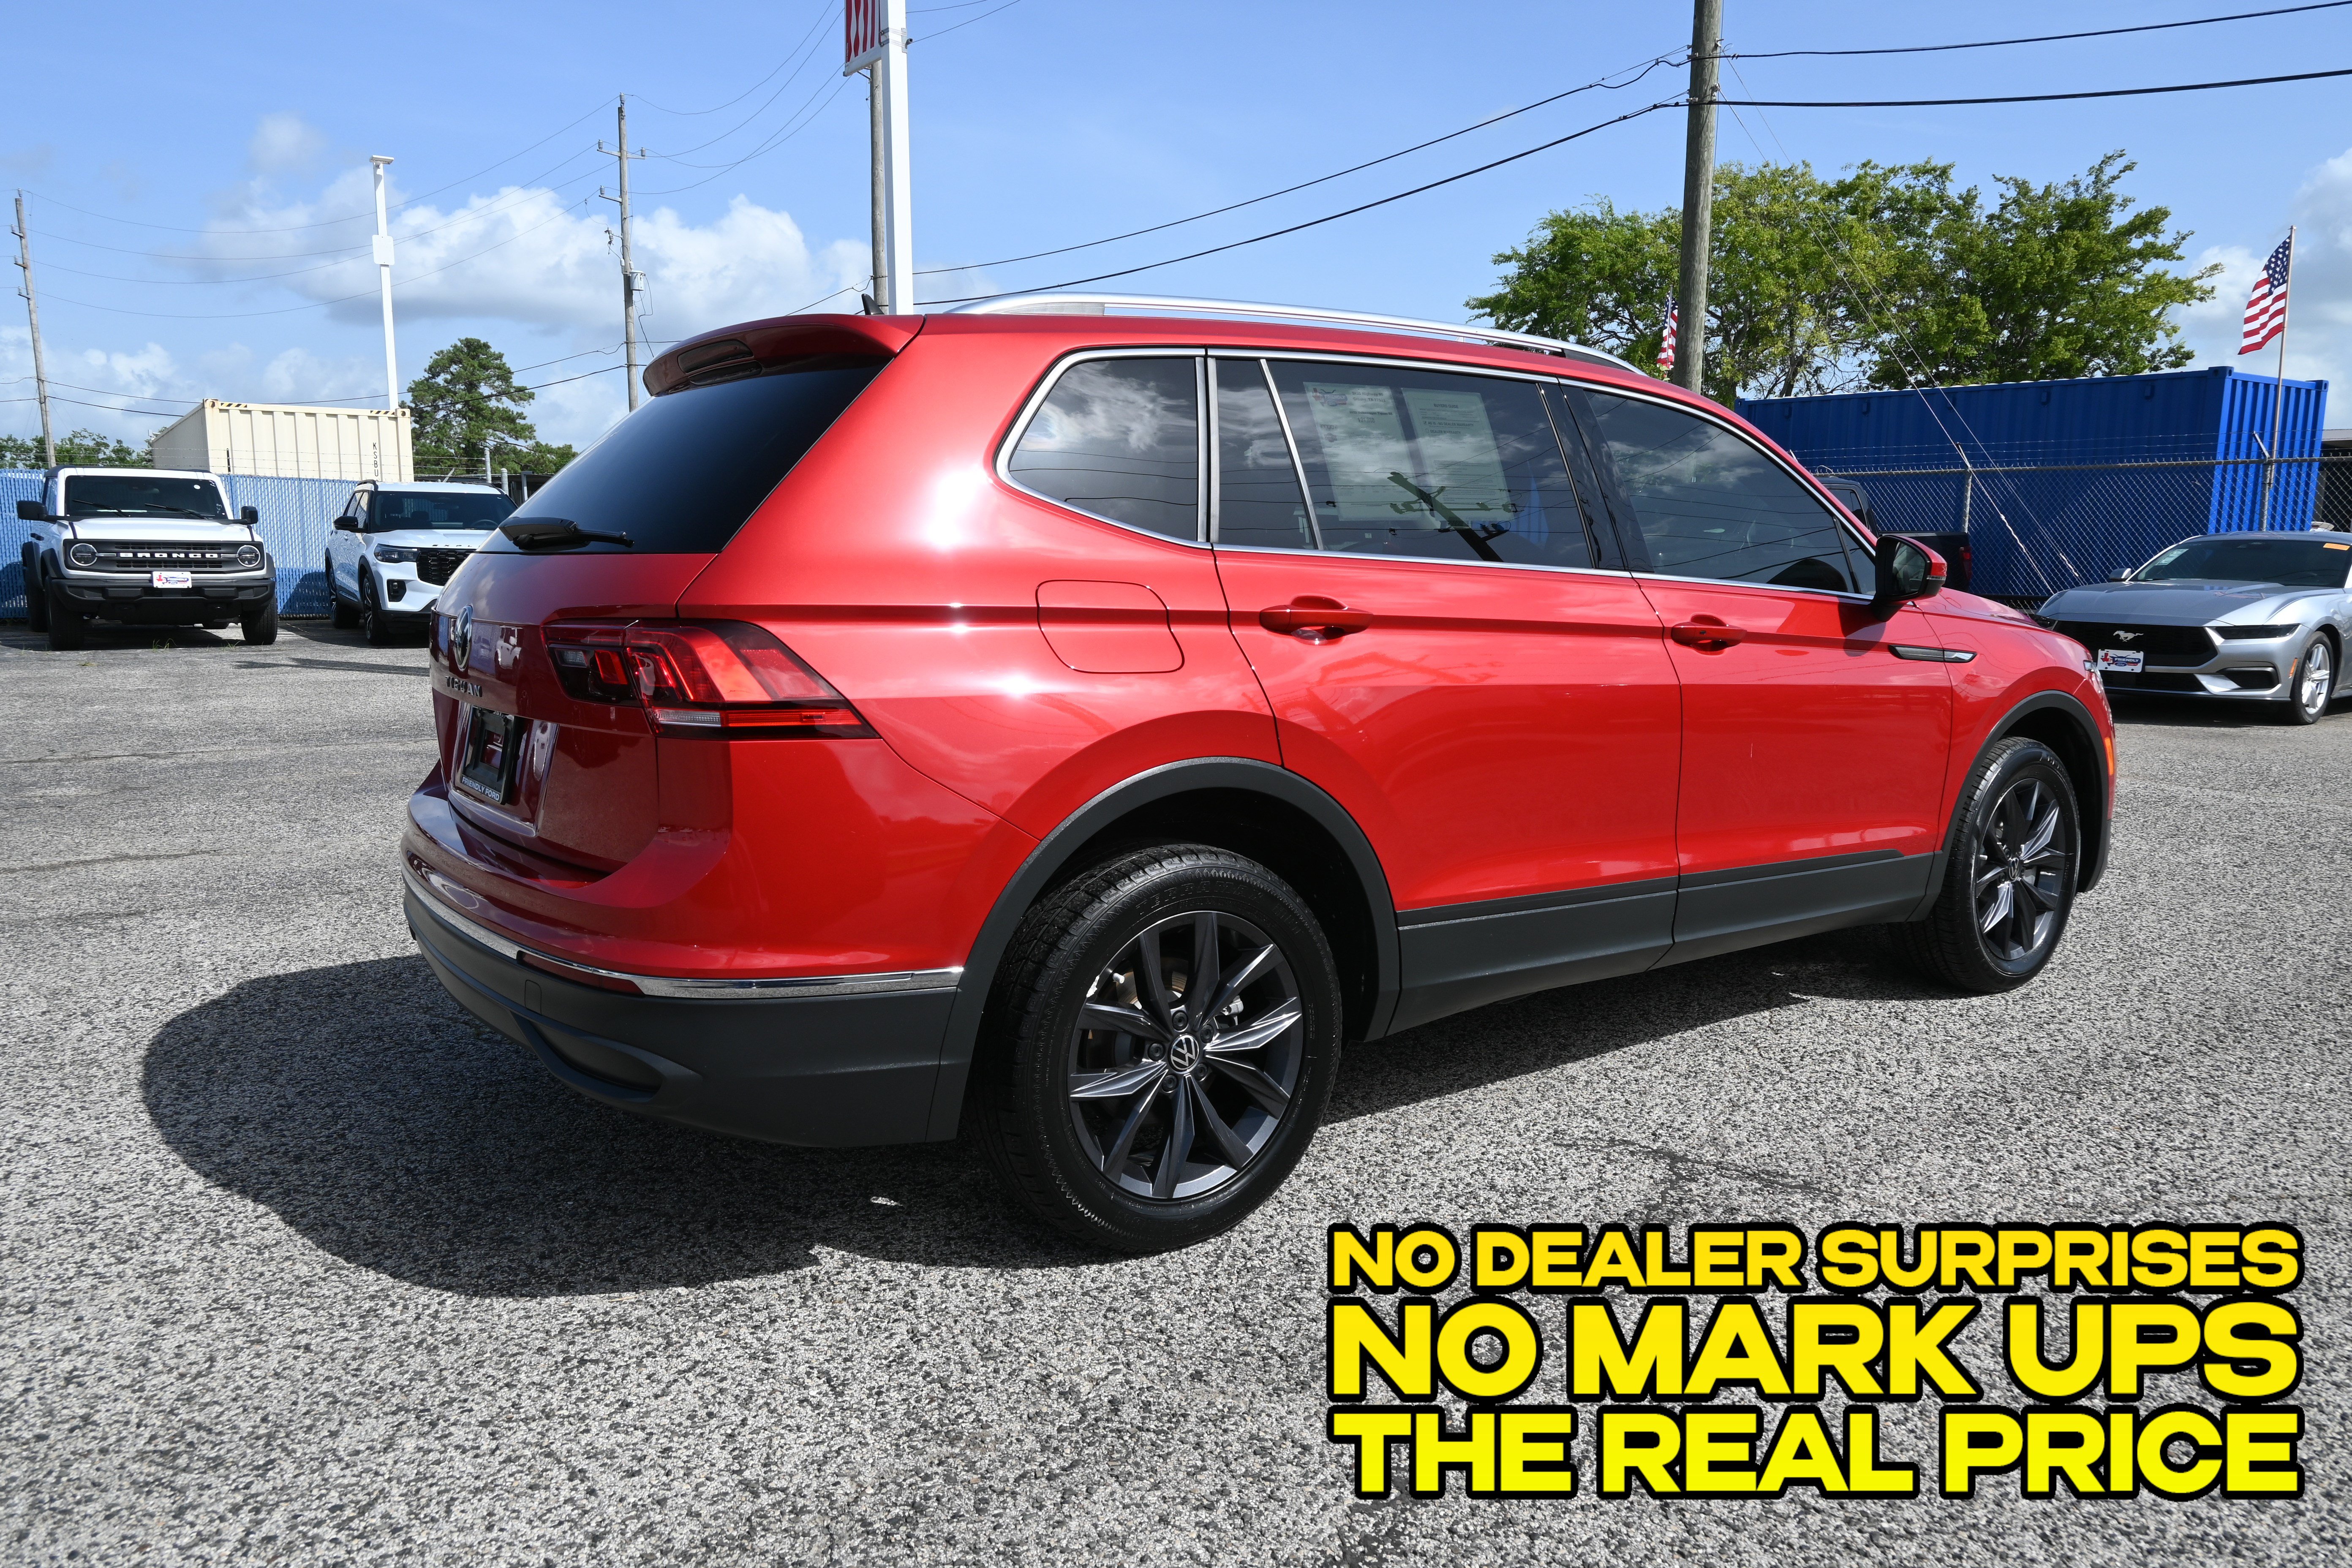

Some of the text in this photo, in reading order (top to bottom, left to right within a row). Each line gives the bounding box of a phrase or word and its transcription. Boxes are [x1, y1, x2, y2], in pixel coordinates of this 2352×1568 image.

[445, 676, 483, 697] TIGUAN
[462, 776, 500, 801] FRIENDLY FORD
